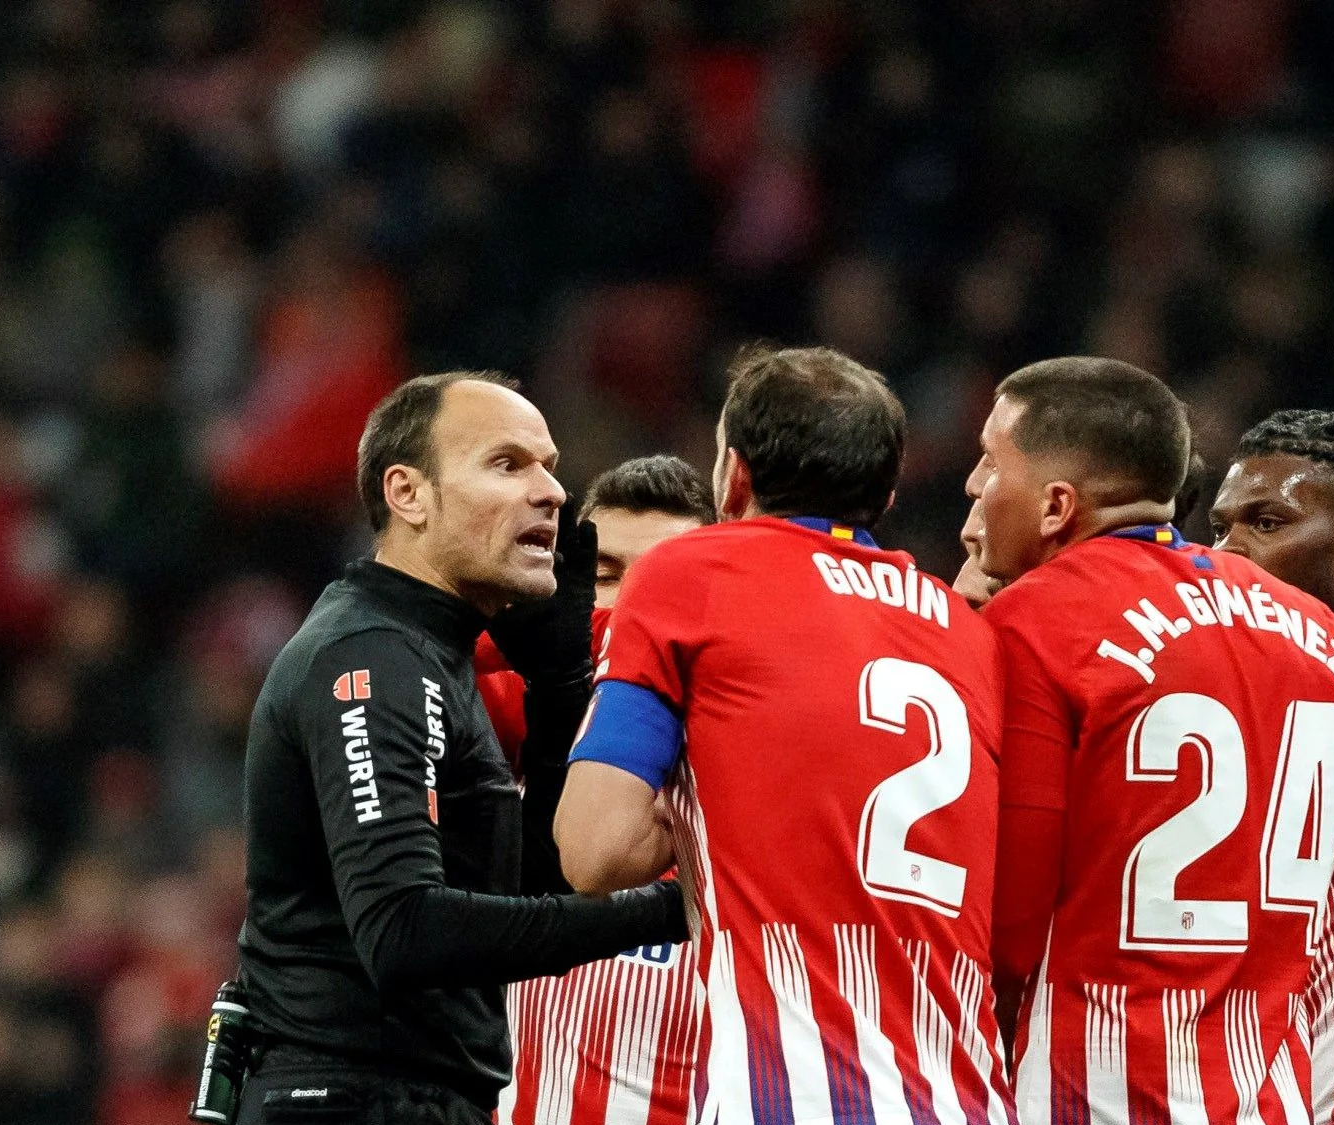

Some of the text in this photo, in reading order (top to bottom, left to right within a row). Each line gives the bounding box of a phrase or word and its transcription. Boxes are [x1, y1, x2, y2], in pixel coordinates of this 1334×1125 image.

[811, 551, 950, 630] GODÍN
[340, 705, 383, 824] WÜRTH
[856, 656, 972, 919] 2
